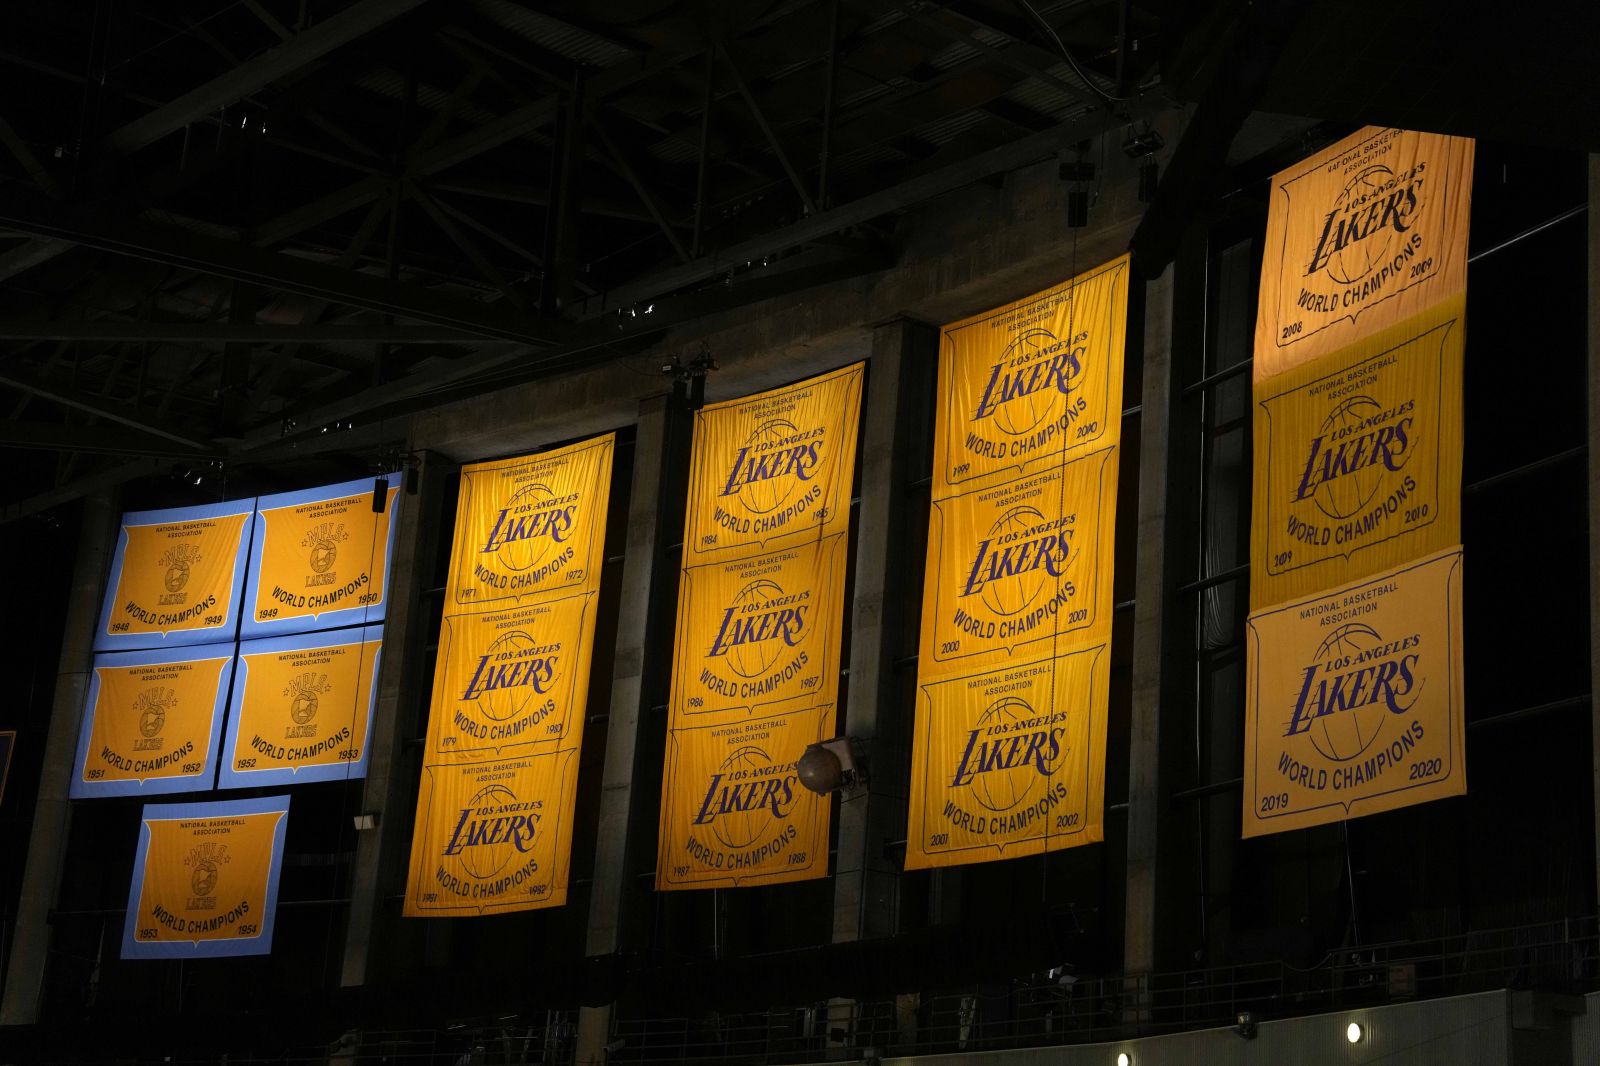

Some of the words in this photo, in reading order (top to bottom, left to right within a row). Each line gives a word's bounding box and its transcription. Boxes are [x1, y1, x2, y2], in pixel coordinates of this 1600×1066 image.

[1344, 194, 1367, 214] LOS
[1367, 162, 1426, 200] ANGELES
[1303, 180, 1423, 277] LAKERS
[1298, 288, 1338, 313] WORLD
[1343, 233, 1422, 308] CHAMPIONS
[992, 311, 1025, 328] NATIONAL
[1027, 294, 1073, 315] BASKETBALL
[1008, 310, 1054, 333] ASSOCIATION
[1282, 321, 1303, 339] 2008
[1010, 353, 1031, 368] LOS
[1032, 331, 1088, 358] ANGELES
[970, 347, 1086, 422] LAKERS
[1309, 378, 1345, 397] NATIONAL
[1348, 355, 1398, 382] BASKETBALL
[1328, 375, 1378, 400] ASSOCIATION
[739, 403, 770, 415] NATIONAL
[772, 390, 813, 407] BASKETBALL
[754, 404, 796, 420] ASSOCIATION
[965, 432, 1006, 458] WORLD
[1011, 397, 1087, 458] CHAMPIONS
[1331, 426, 1354, 442] LOS
[1355, 400, 1415, 434] ANGELES
[755, 440, 775, 452] LOS
[776, 427, 825, 446] ANGELES
[501, 467, 530, 478] NATIONAL
[532, 458, 569, 472] BASKETBALL
[718, 440, 824, 497] LAKERS
[1291, 417, 1414, 503] LAKERS
[515, 471, 554, 484] ASSOCIATION
[979, 489, 1012, 502] NATIONAL
[1015, 472, 1061, 492] BASKETBALL
[296, 504, 323, 514] NATIONAL
[326, 498, 362, 508] BASKETBALL
[514, 504, 531, 514] LOS
[534, 493, 580, 510] ANGELES
[714, 506, 750, 533] WORLD
[754, 484, 821, 534] CHAMPIONS
[995, 488, 1043, 508] ASSOCIATION
[310, 508, 347, 518] ASSOCIATION
[1288, 515, 1331, 546] WORLD
[1336, 475, 1416, 545] CHAMPIONS
[479, 505, 577, 553] LAKERS
[998, 532, 1019, 545] LOS
[1020, 514, 1076, 538] ANGELES
[474, 562, 507, 589] WORLD
[510, 546, 574, 589] CHAMPIONS
[725, 562, 756, 573] NATIONAL
[758, 552, 799, 567] BASKETBALL
[740, 565, 782, 579] ASSOCIATION
[958, 530, 1074, 597] LAKERS
[566, 570, 583, 581] 1972
[272, 586, 305, 608] WORLD
[308, 572, 368, 608] CHAMPIONS
[741, 602, 760, 613] LOS
[761, 590, 810, 610] ANGELES
[1300, 600, 1340, 619] NATIONAL
[1343, 583, 1398, 607] BASKETBALL
[125, 601, 156, 625] WORLD
[158, 595, 216, 625] CHAMPIONS
[204, 615, 222, 624] 1949
[260, 608, 278, 618] 1949
[482, 614, 511, 623] NATIONAL
[513, 607, 552, 619] BASKETBALL
[954, 608, 995, 639] WORLD
[1000, 581, 1076, 639] CHAMPIONS
[1068, 609, 1088, 624] 2001
[1320, 602, 1378, 627] ASSOCIATION
[112, 623, 129, 631] 1948
[496, 618, 535, 630] ASSOCIATION
[704, 606, 809, 658] LAKERS
[308, 648, 346, 658] BASKETBALL
[495, 652, 513, 661] LOS
[515, 643, 561, 658] ANGELES
[941, 640, 960, 654] 2000
[1325, 655, 1351, 673] LOS
[1352, 634, 1421, 665] ANGELES
[158, 665, 192, 673] BASKETBALL
[292, 658, 330, 666] ASSOCIATION
[459, 656, 559, 701] LAKERS
[700, 668, 737, 697] WORLD
[741, 651, 809, 698] CHAMPIONS
[801, 676, 819, 689] 1987
[968, 676, 1002, 689] NATIONAL
[1005, 664, 1052, 681] BASKETBALL
[984, 680, 1033, 696] ASSOCIATION
[1283, 654, 1419, 738] LAKERS
[688, 697, 704, 707] 1986
[454, 710, 488, 739] WORLD
[490, 699, 555, 740] CHAMPIONS
[712, 728, 743, 738] NATIONAL
[745, 720, 787, 732] BASKETBALL
[987, 724, 1008, 736] LOS
[1010, 712, 1067, 732] ANGELES
[251, 734, 284, 760] WORLD
[288, 727, 350, 760] CHAMPIONS
[727, 732, 770, 744] ASSOCIATION
[101, 745, 132, 771] WORLD
[134, 741, 194, 772] CHAMPIONS
[238, 759, 256, 768] 1952
[338, 750, 358, 760] 1953
[948, 727, 1065, 788] LAKERS
[1278, 752, 1327, 790] WORLD
[1333, 720, 1424, 790] CHAMPIONS
[88, 770, 104, 778] 1951
[182, 763, 200, 772] 1952
[462, 766, 491, 775] NATIONAL
[493, 761, 532, 772] BASKETBALL
[476, 773, 516, 782] ASSOCIATION
[728, 769, 748, 781] LOS
[750, 761, 799, 777] ANGELES
[1409, 758, 1442, 781] 2020
[476, 807, 494, 816] LOS
[496, 800, 543, 813] ANGELES
[692, 774, 798, 825] LAKERS
[943, 800, 986, 834] WORLD
[990, 782, 1067, 835] CHAMPIONS
[1261, 793, 1289, 812] 2019
[1056, 813, 1078, 827] 2002
[442, 809, 541, 856] LAKERS
[931, 834, 948, 846] 2001
[686, 836, 723, 868] WORLD
[728, 824, 797, 869] CHAMPIONS
[788, 852, 806, 864] 1988
[436, 865, 469, 897] WORLD
[473, 859, 538, 898] CHAMPIONS
[673, 866, 690, 877] 1987
[152, 904, 185, 931] WORLD
[188, 901, 249, 933] CHAMPIONS
[140, 929, 158, 938] 1953
[238, 925, 257, 934] 1954
